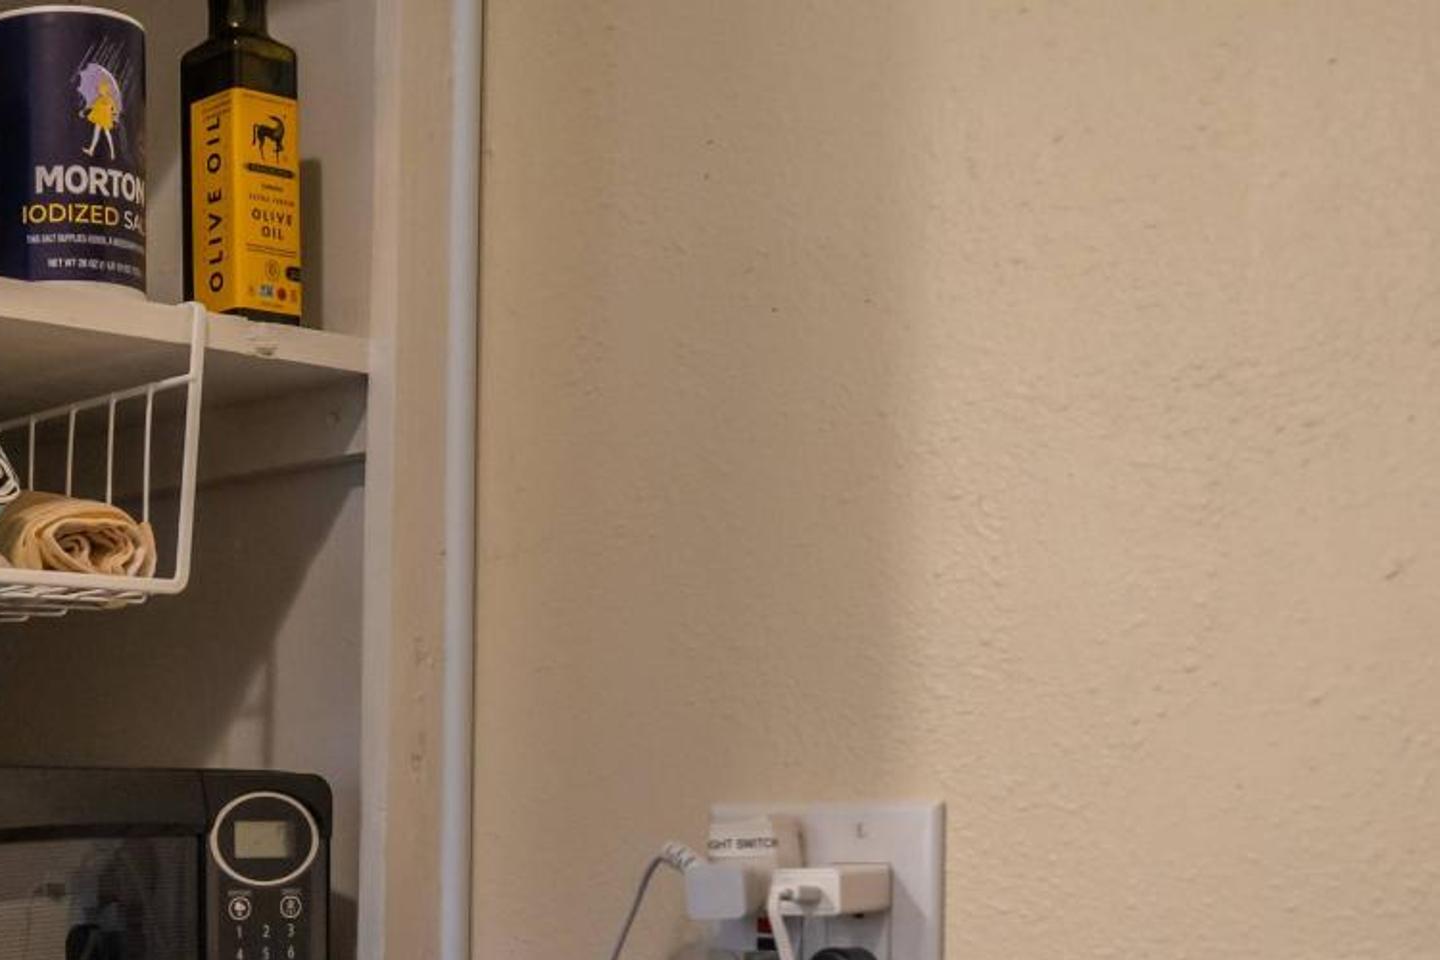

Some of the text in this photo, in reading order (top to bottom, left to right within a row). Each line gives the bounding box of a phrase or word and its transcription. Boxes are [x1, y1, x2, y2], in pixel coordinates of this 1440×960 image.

[35, 164, 145, 207] MORTON
[207, 114, 224, 293] OLIVE OIL
[22, 203, 145, 235] IODIZED SA
[251, 207, 293, 227] OLIVE
[261, 224, 285, 241] OIL
[262, 924, 271, 938] 2
[287, 923, 295, 938] 3
[262, 946, 270, 960] 5
[287, 944, 295, 959] 6
